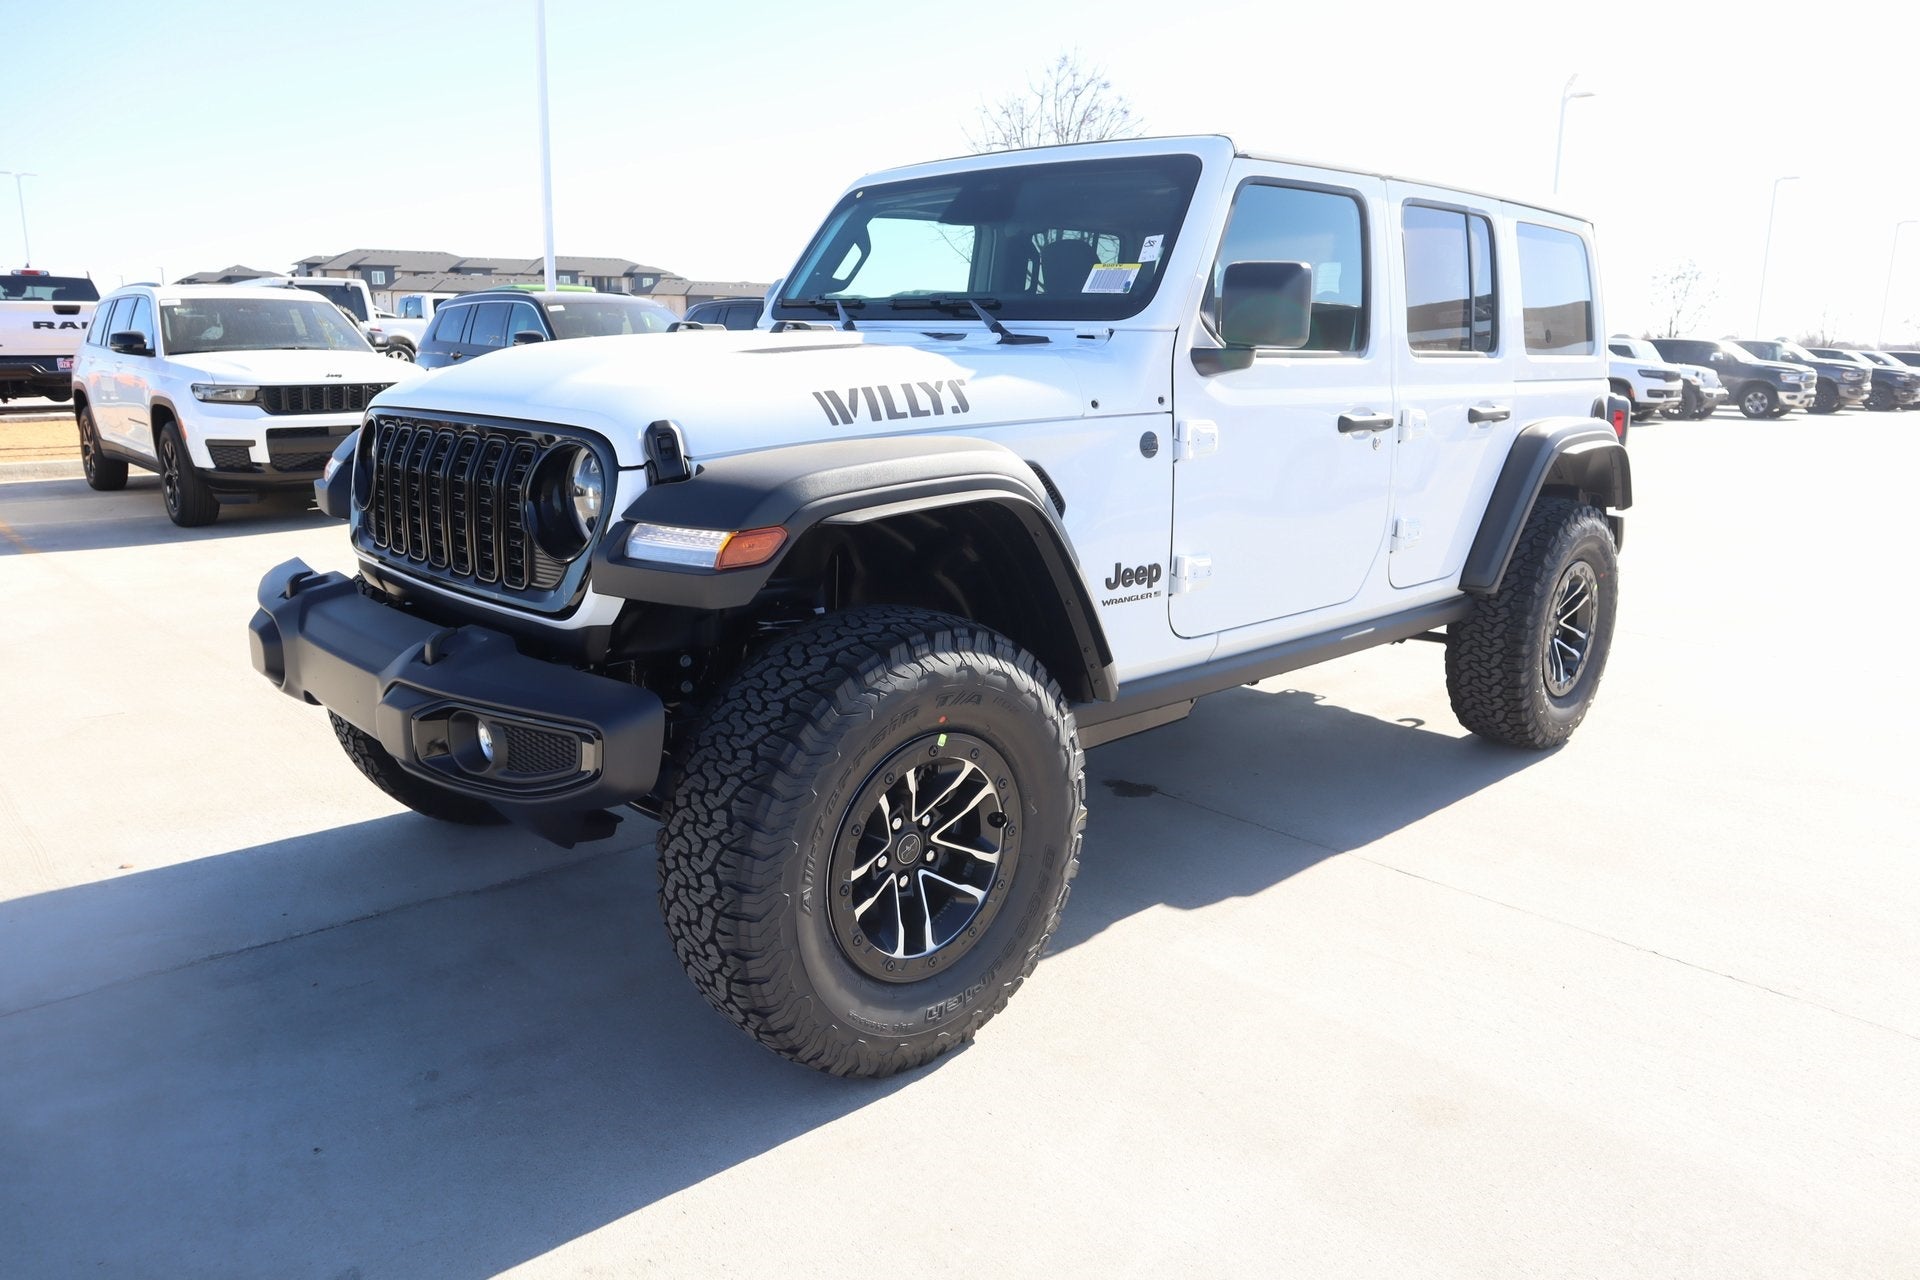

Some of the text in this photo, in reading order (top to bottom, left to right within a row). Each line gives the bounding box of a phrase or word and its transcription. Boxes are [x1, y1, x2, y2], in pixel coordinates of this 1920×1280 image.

[812, 379, 970, 426] WILLYS
[1105, 562, 1162, 590] Jeep
[1101, 592, 1153, 607] WRANGLER
[935, 690, 983, 708] T/A
